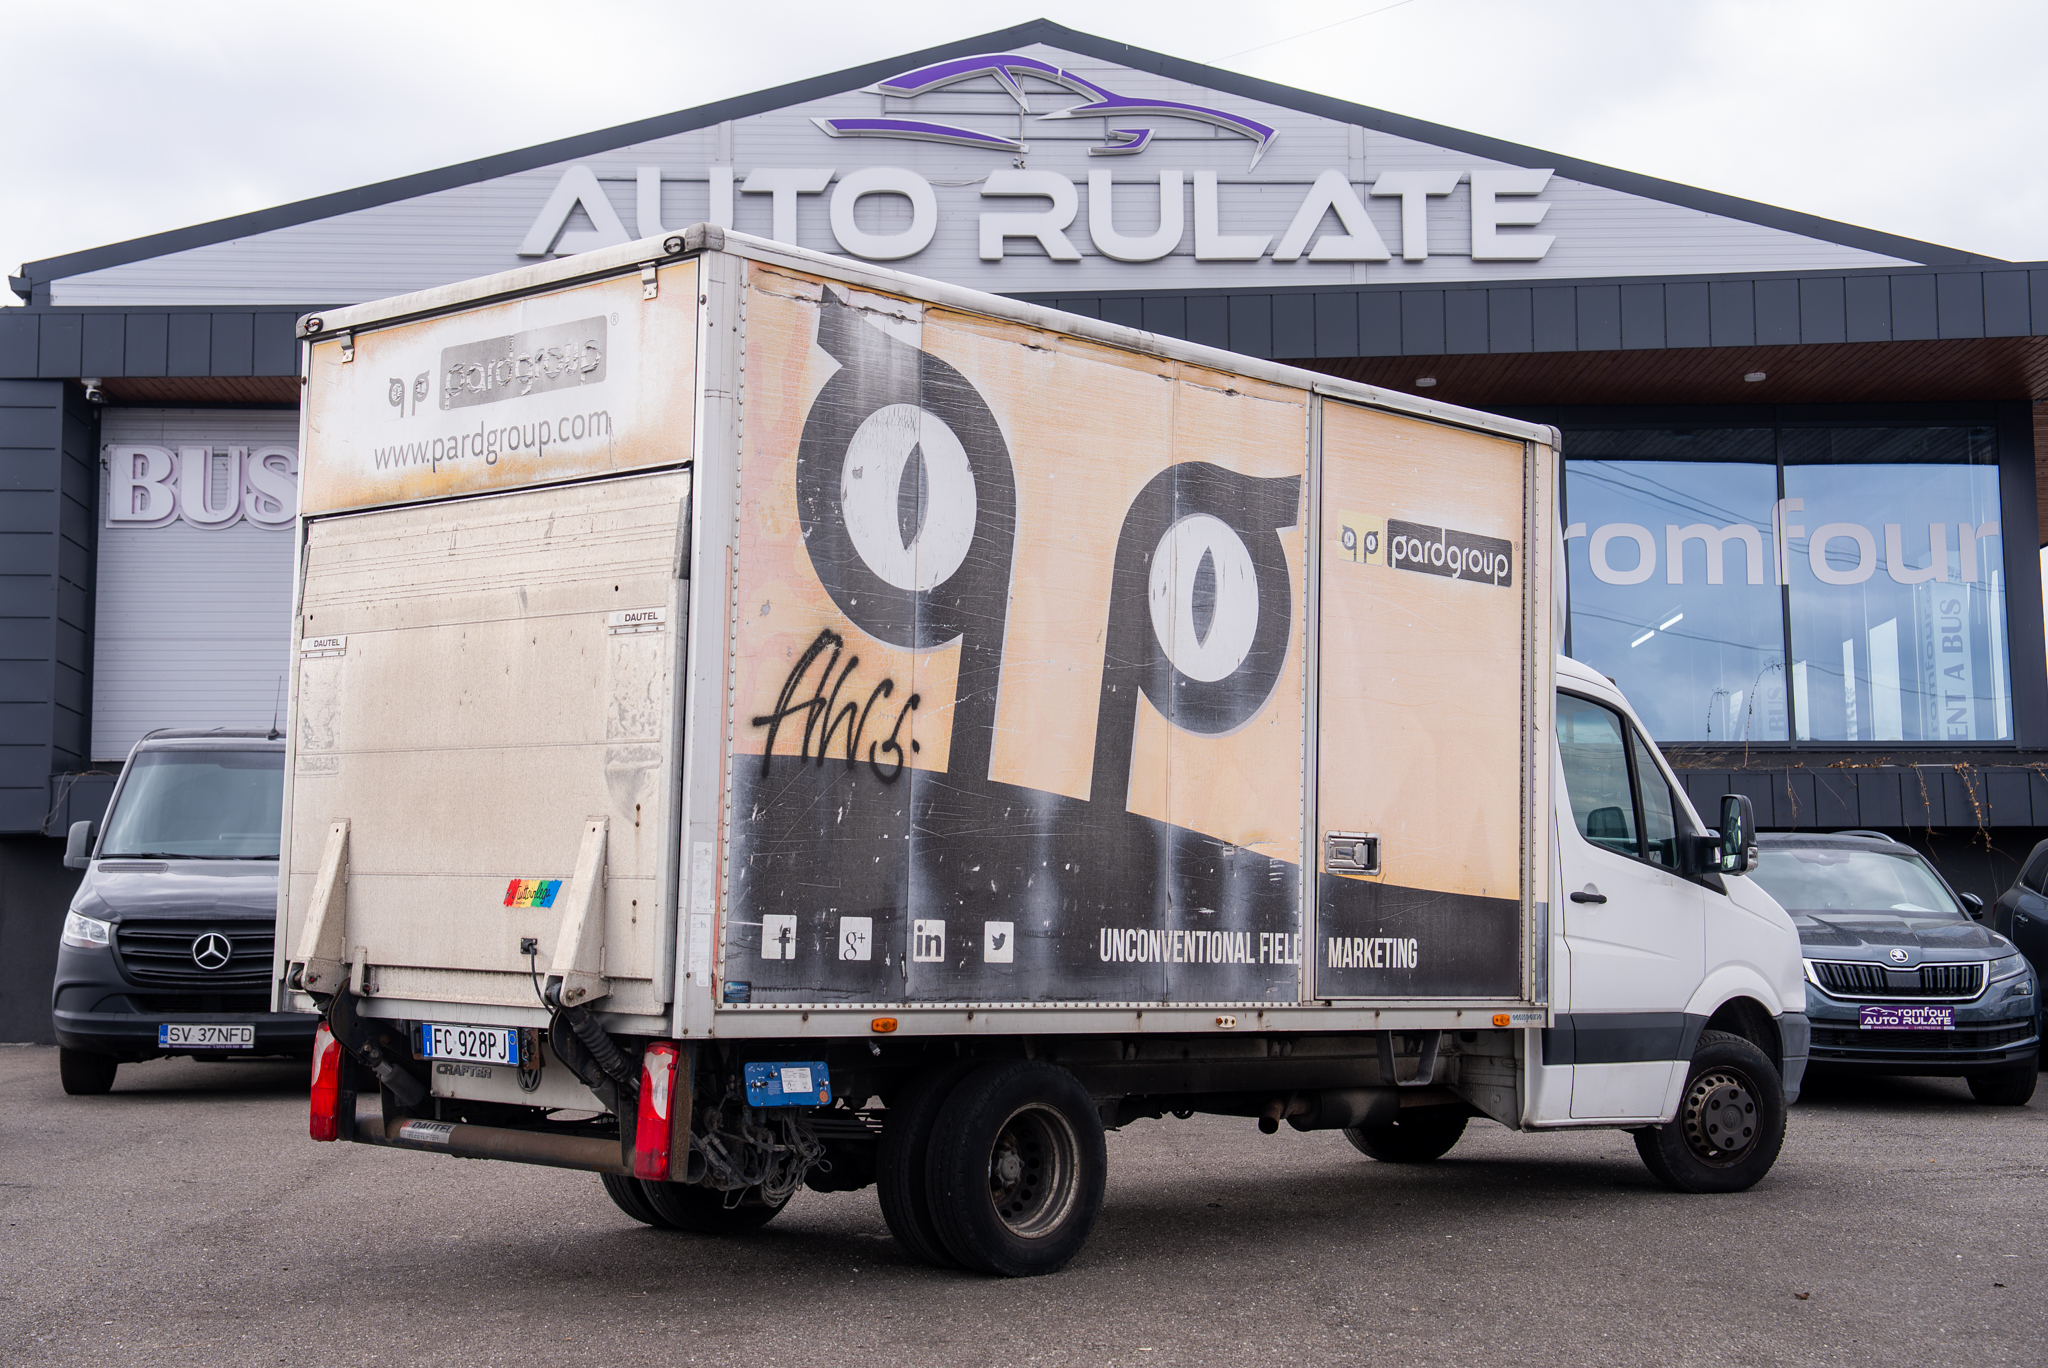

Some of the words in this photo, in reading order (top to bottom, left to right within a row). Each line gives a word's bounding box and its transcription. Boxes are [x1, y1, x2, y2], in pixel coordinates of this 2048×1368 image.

[516, 165, 938, 260] AUTO
[979, 168, 1557, 263] RULATE
[374, 410, 610, 473] www.pardgroup.com
[105, 444, 298, 530] BUS
[1392, 528, 1509, 586] pardgroup
[624, 612, 658, 622] DAUTEL
[1939, 598, 1963, 653] BUS
[314, 639, 340, 648] DAUTEL
[1944, 663, 1965, 681] A
[1768, 685, 1785, 732] BUS
[1945, 690, 1968, 740] ENT
[915, 924, 942, 957] in
[1100, 928, 1256, 964] UNCONVENTIONAL
[1328, 938, 1418, 969] MARKETING
[1864, 1016, 1899, 1025] AUTO
[1902, 1016, 1952, 1025] RULATE
[1898, 1006, 1951, 1017] romfour
[169, 1027, 192, 1042] SV
[198, 1027, 252, 1043] 37NFD
[434, 1028, 453, 1055] FC
[458, 1030, 507, 1060] 928PJ
[436, 1063, 492, 1079] CRAFTER
[411, 1121, 453, 1134] DAUTEL
